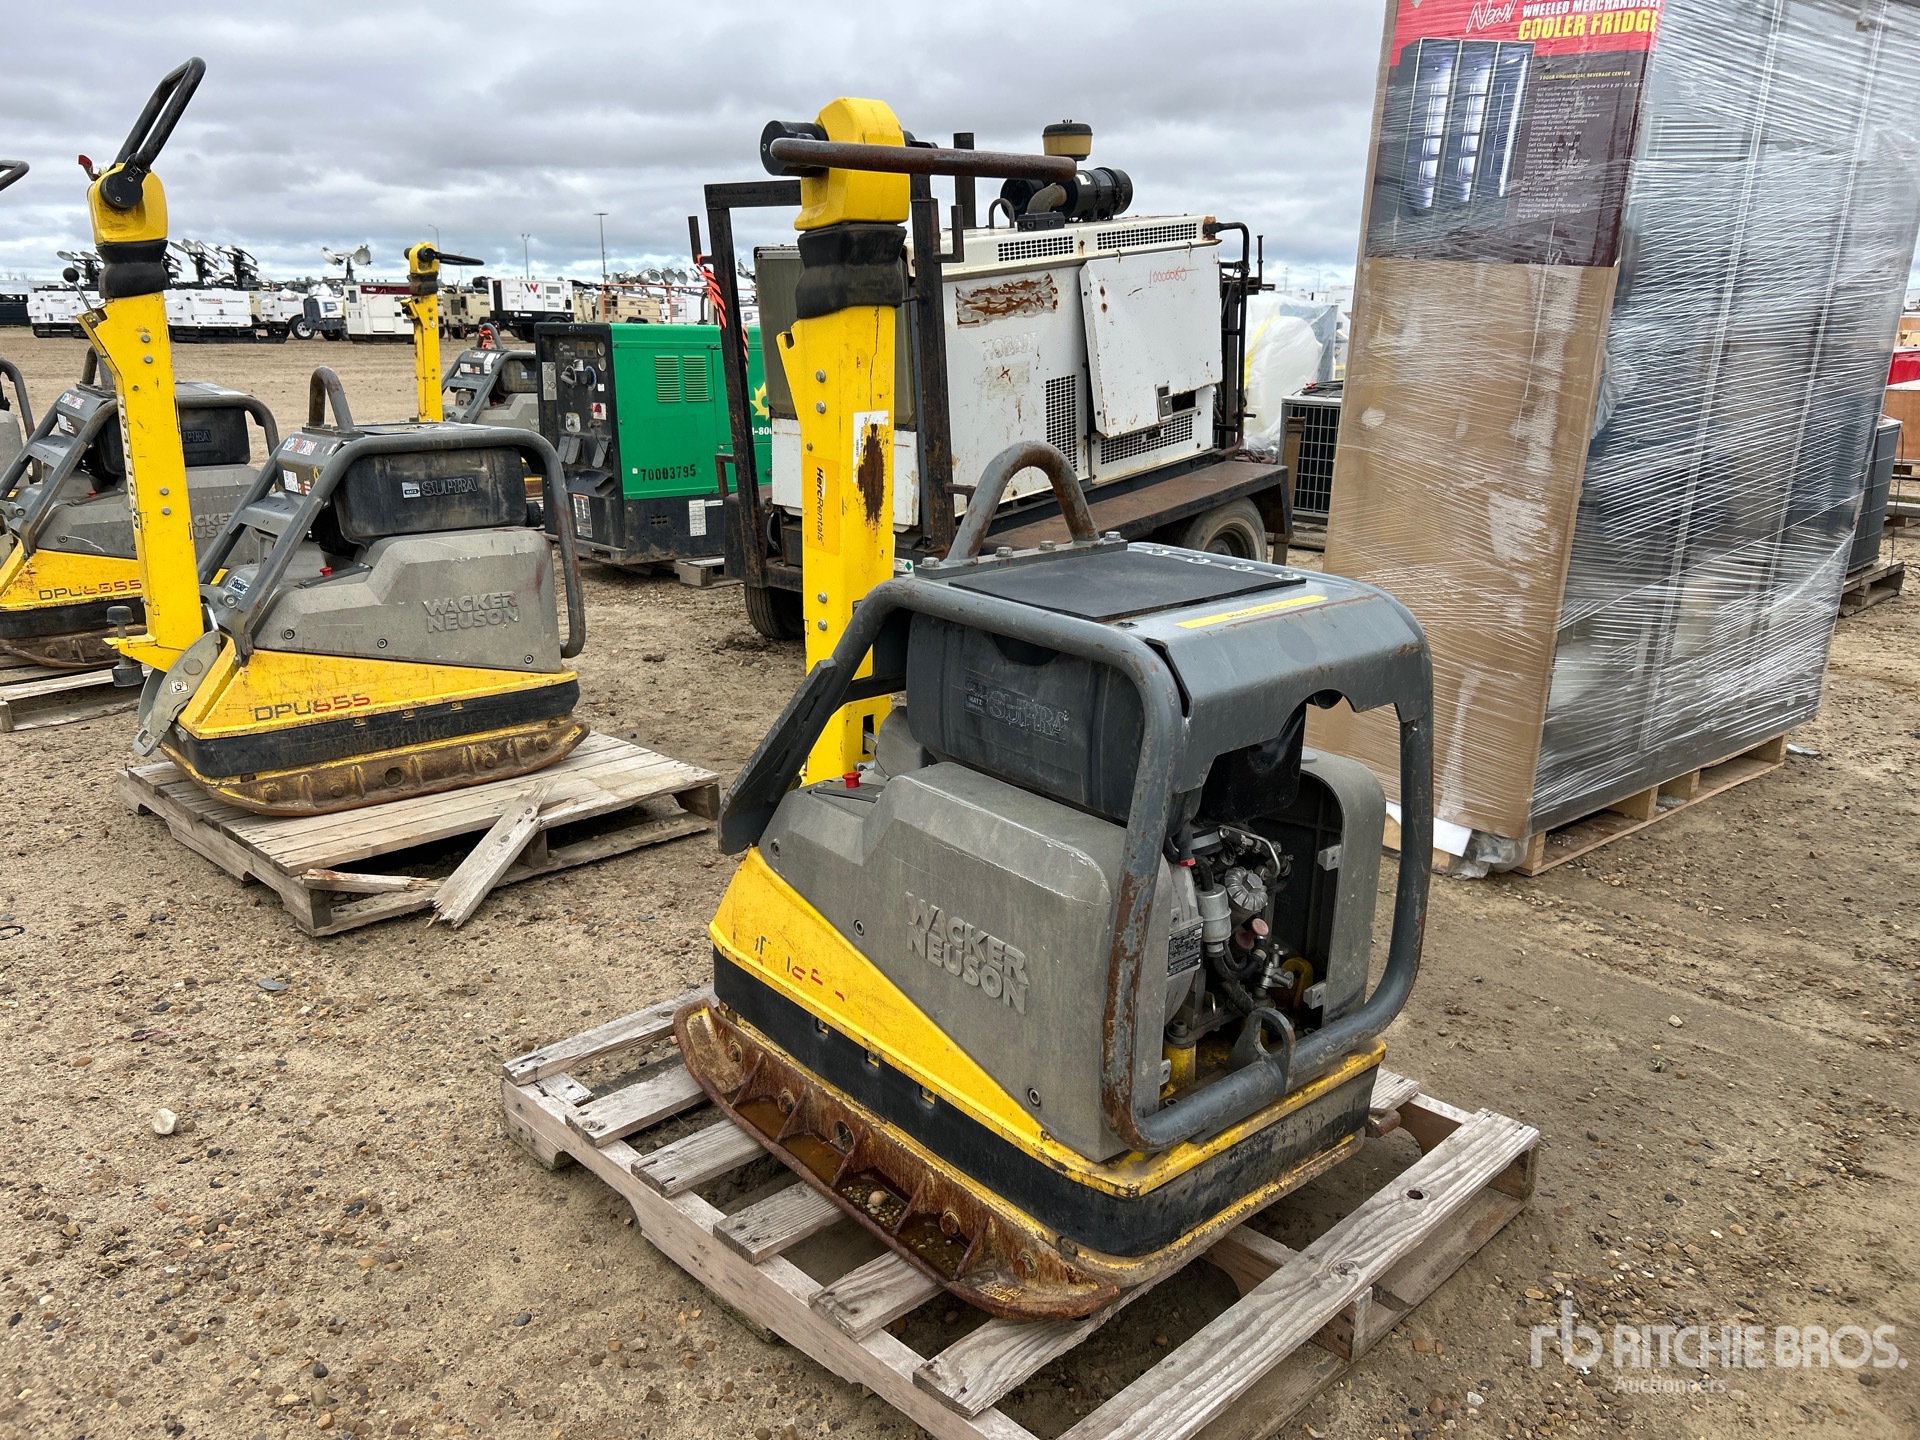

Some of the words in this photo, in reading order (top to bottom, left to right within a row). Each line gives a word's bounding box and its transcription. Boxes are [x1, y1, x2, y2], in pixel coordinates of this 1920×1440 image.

[1523, 2, 1570, 17] WHEELED
[1518, 15, 1586, 41] COOLER
[640, 464, 697, 482] 70003795
[421, 478, 477, 497] SUPRA
[816, 466, 825, 542] HercRentals
[422, 591, 518, 617] WACKER
[426, 607, 519, 633] NEUSON
[905, 891, 1029, 987] WACKER
[906, 921, 1028, 1015] NEUSON
